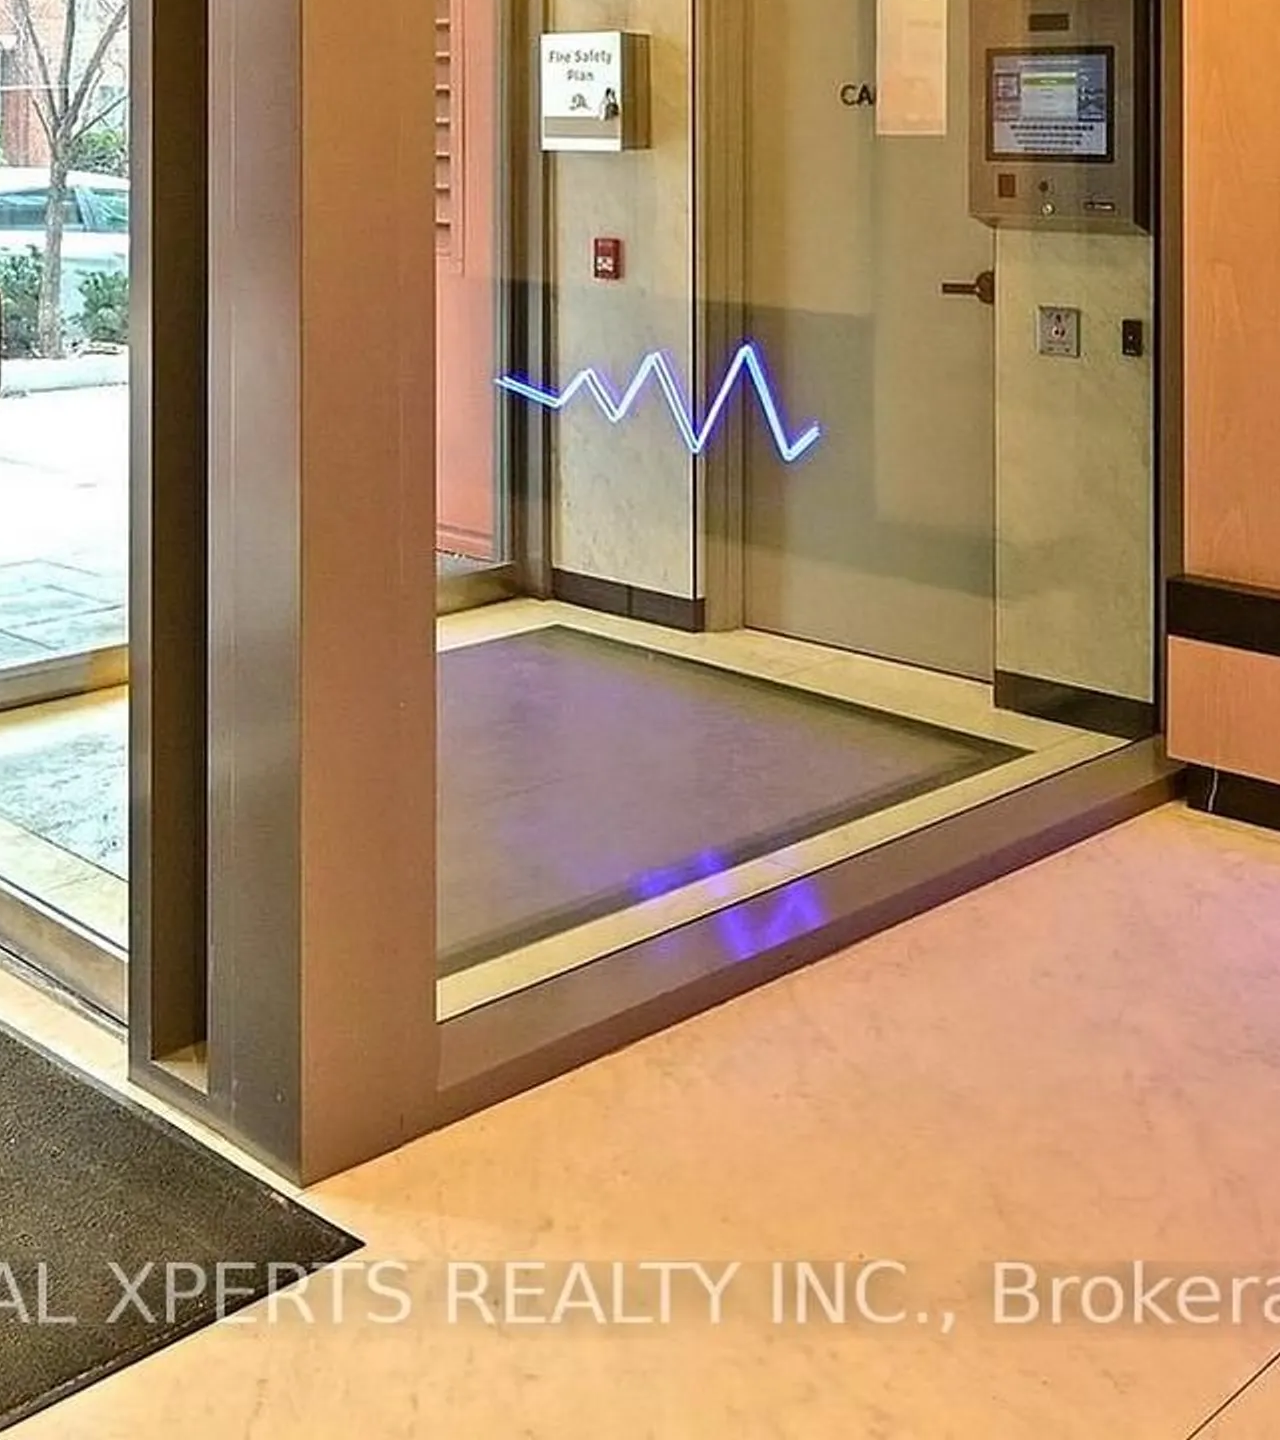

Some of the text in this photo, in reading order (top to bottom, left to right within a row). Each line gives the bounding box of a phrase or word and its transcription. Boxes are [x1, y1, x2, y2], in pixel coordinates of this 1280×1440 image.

[548, 49, 612, 65] Fire Safety
[566, 69, 595, 82] Plan
[840, 83, 876, 106] CA
